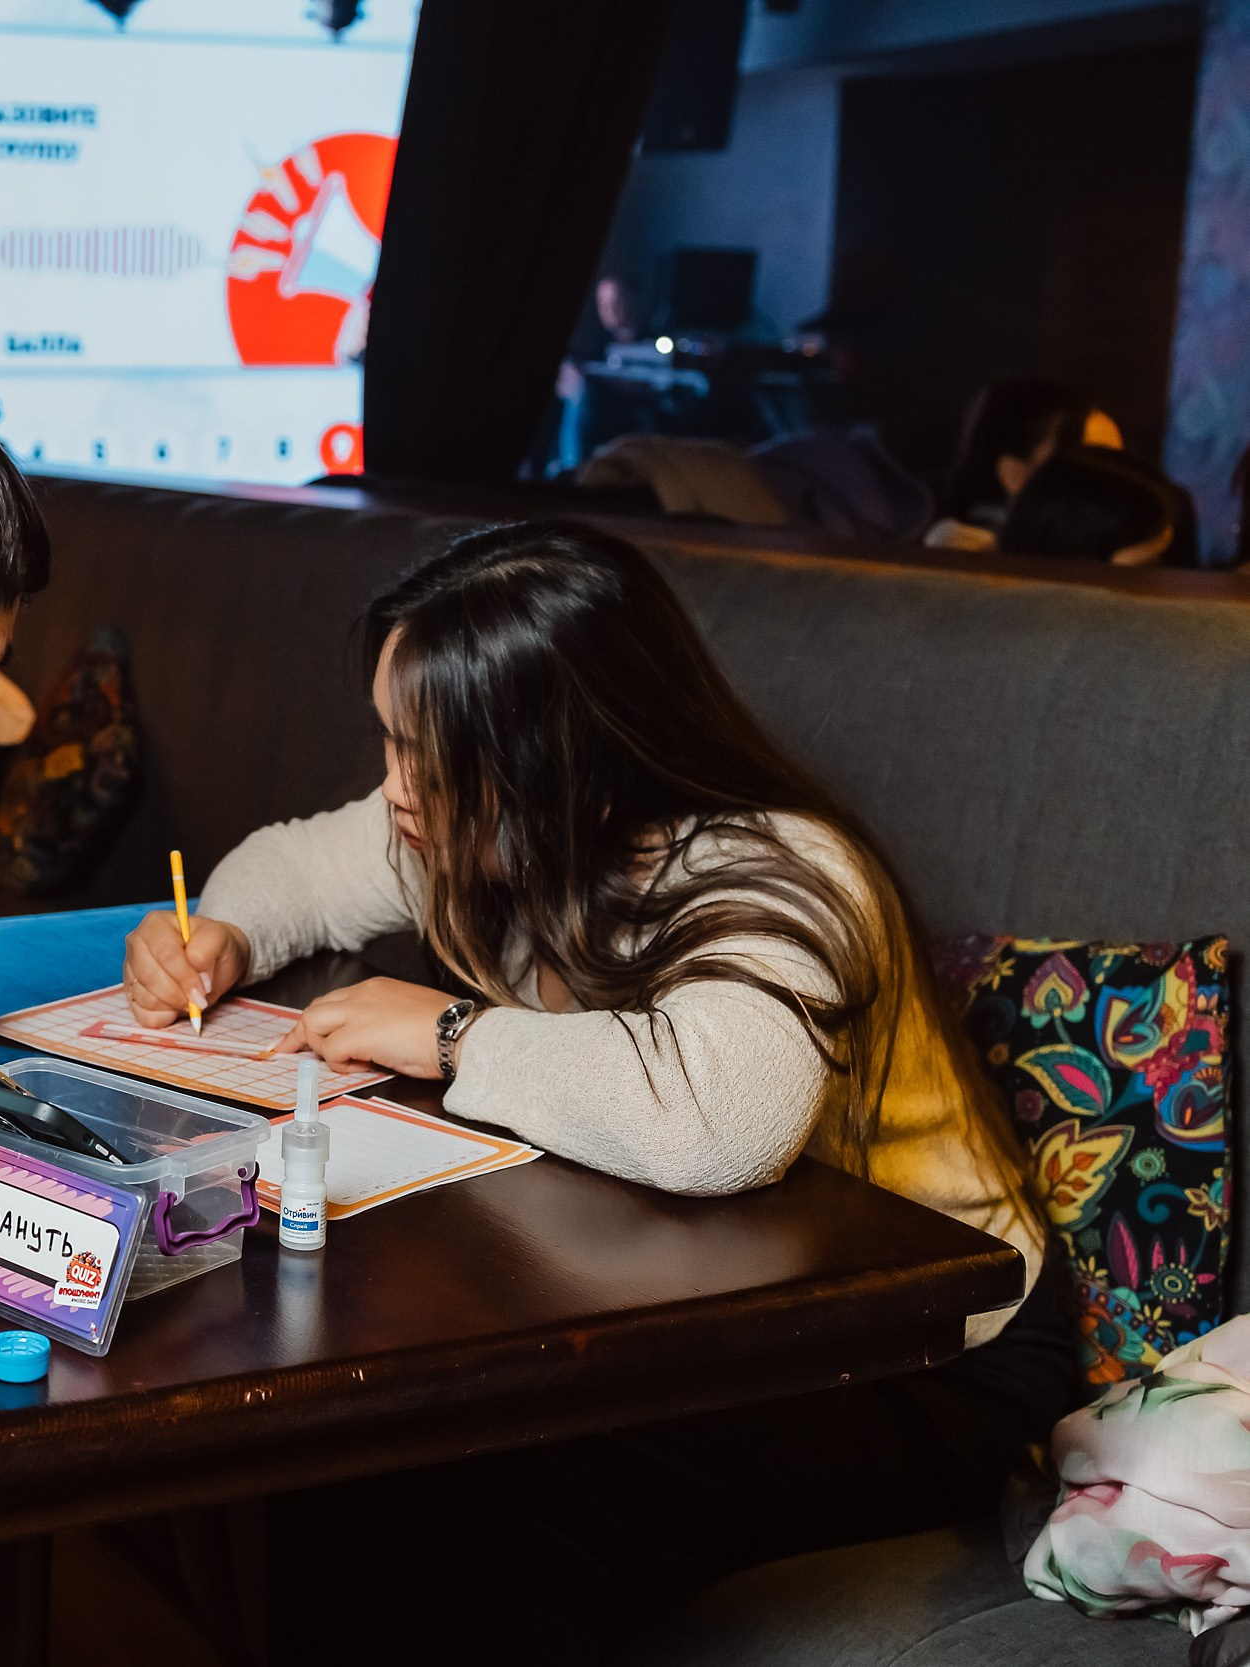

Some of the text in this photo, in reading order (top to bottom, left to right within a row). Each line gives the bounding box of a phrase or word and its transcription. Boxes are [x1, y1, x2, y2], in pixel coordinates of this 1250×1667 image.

[283, 1206, 317, 1219] Отривин
[289, 1222, 308, 1230] Спрей
[71, 1264, 98, 1286] QUIZ
